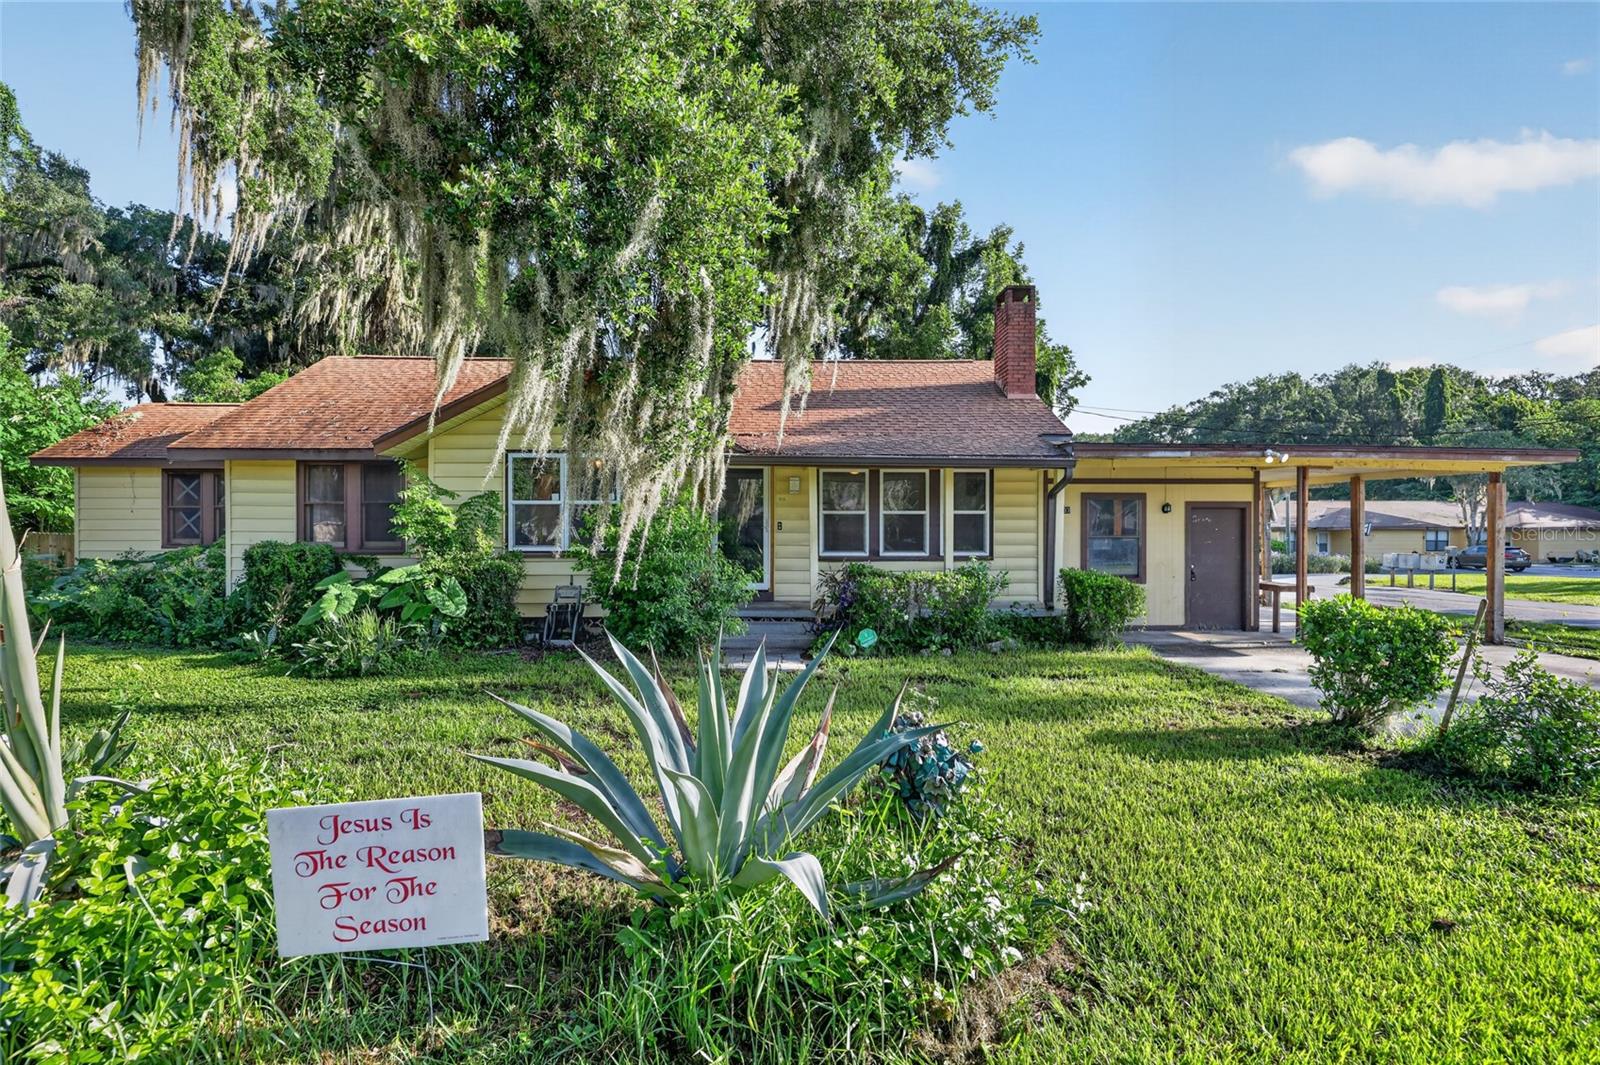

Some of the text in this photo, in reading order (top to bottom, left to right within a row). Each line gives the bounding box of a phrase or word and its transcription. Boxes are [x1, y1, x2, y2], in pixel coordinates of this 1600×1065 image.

[316, 808, 432, 845] Jesus Is
[293, 845, 456, 878] The Reason
[317, 876, 438, 910] For The
[332, 915, 427, 943] Season
